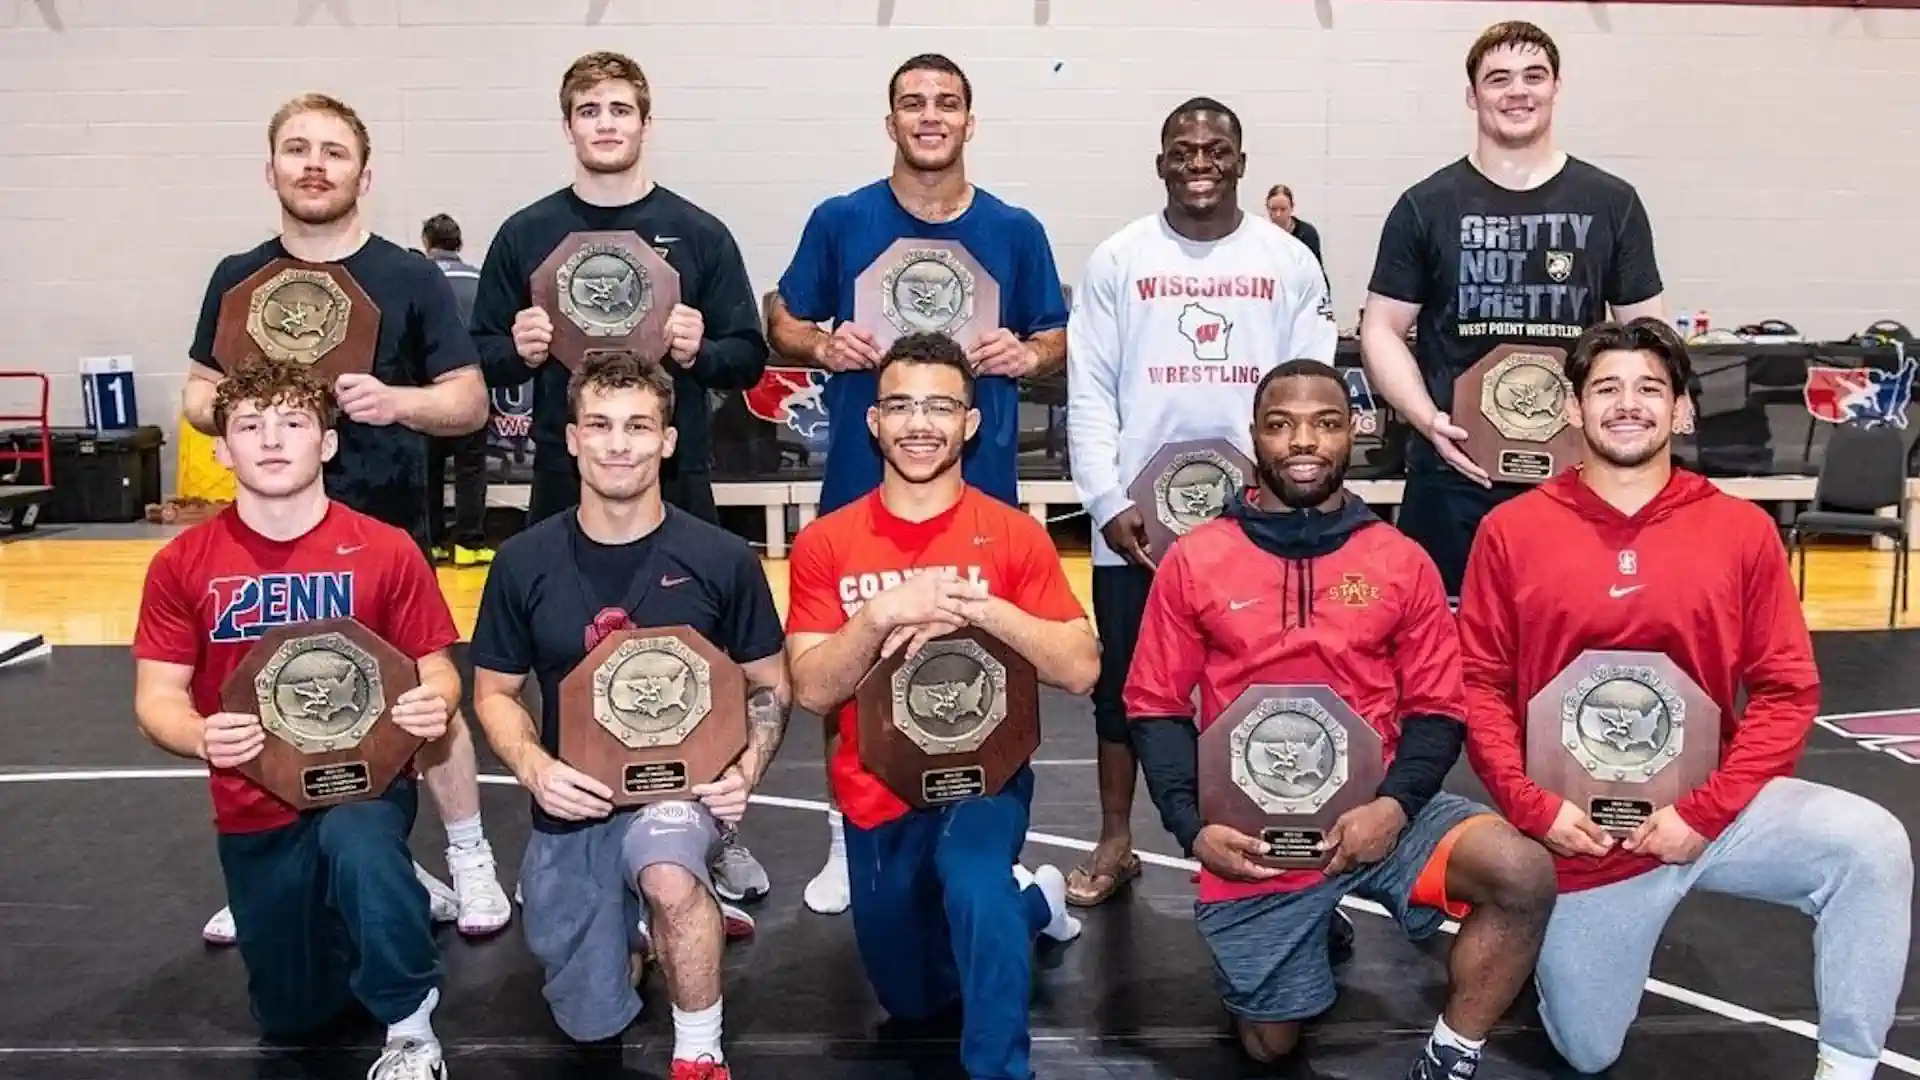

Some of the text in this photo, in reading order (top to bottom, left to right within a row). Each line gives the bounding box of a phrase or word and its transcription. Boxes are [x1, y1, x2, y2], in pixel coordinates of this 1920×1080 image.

[1459, 213, 1593, 250] GRITTY
[1459, 250, 1528, 284] NOT
[1136, 275, 1276, 301] WISCONSIN
[1458, 285, 1588, 320] PRETTY
[1458, 323, 1488, 337] WEST
[1489, 321, 1524, 336] POINT
[1148, 363, 1260, 384] WRESTLING
[107, 376, 126, 425] 1
[208, 571, 354, 643] PENN
[1328, 584, 1381, 601] STATE
